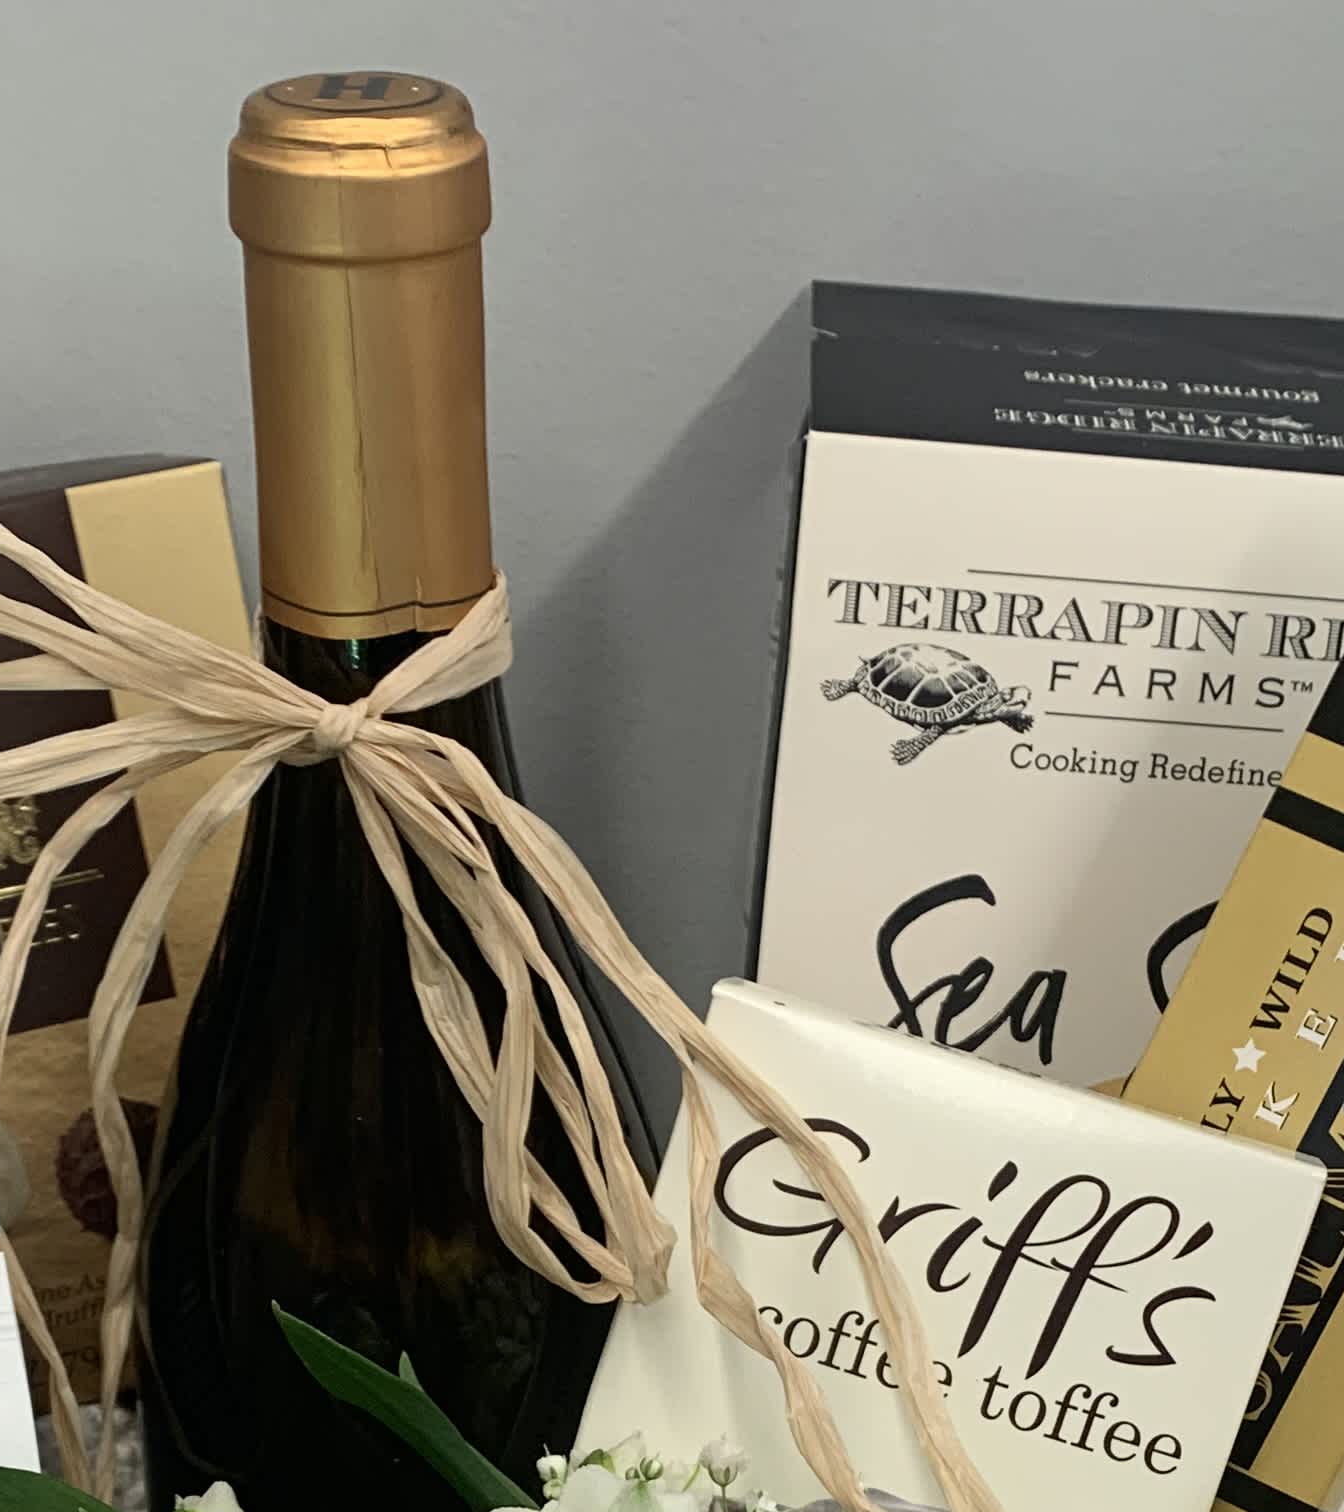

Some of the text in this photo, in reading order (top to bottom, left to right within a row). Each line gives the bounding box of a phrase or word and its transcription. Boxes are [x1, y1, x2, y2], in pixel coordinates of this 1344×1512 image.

[993, 407, 1137, 432] RIDGE
[1023, 369, 1321, 404] gourmet crackers
[826, 578, 1248, 657] TERRAPIN
[1009, 743, 1284, 789] Cooking Redefine
[876, 874, 1067, 1067] Sea
[1248, 907, 1333, 1031] WILD
[713, 1117, 1217, 1380] Griff's
[979, 1365, 1184, 1475] toffee
